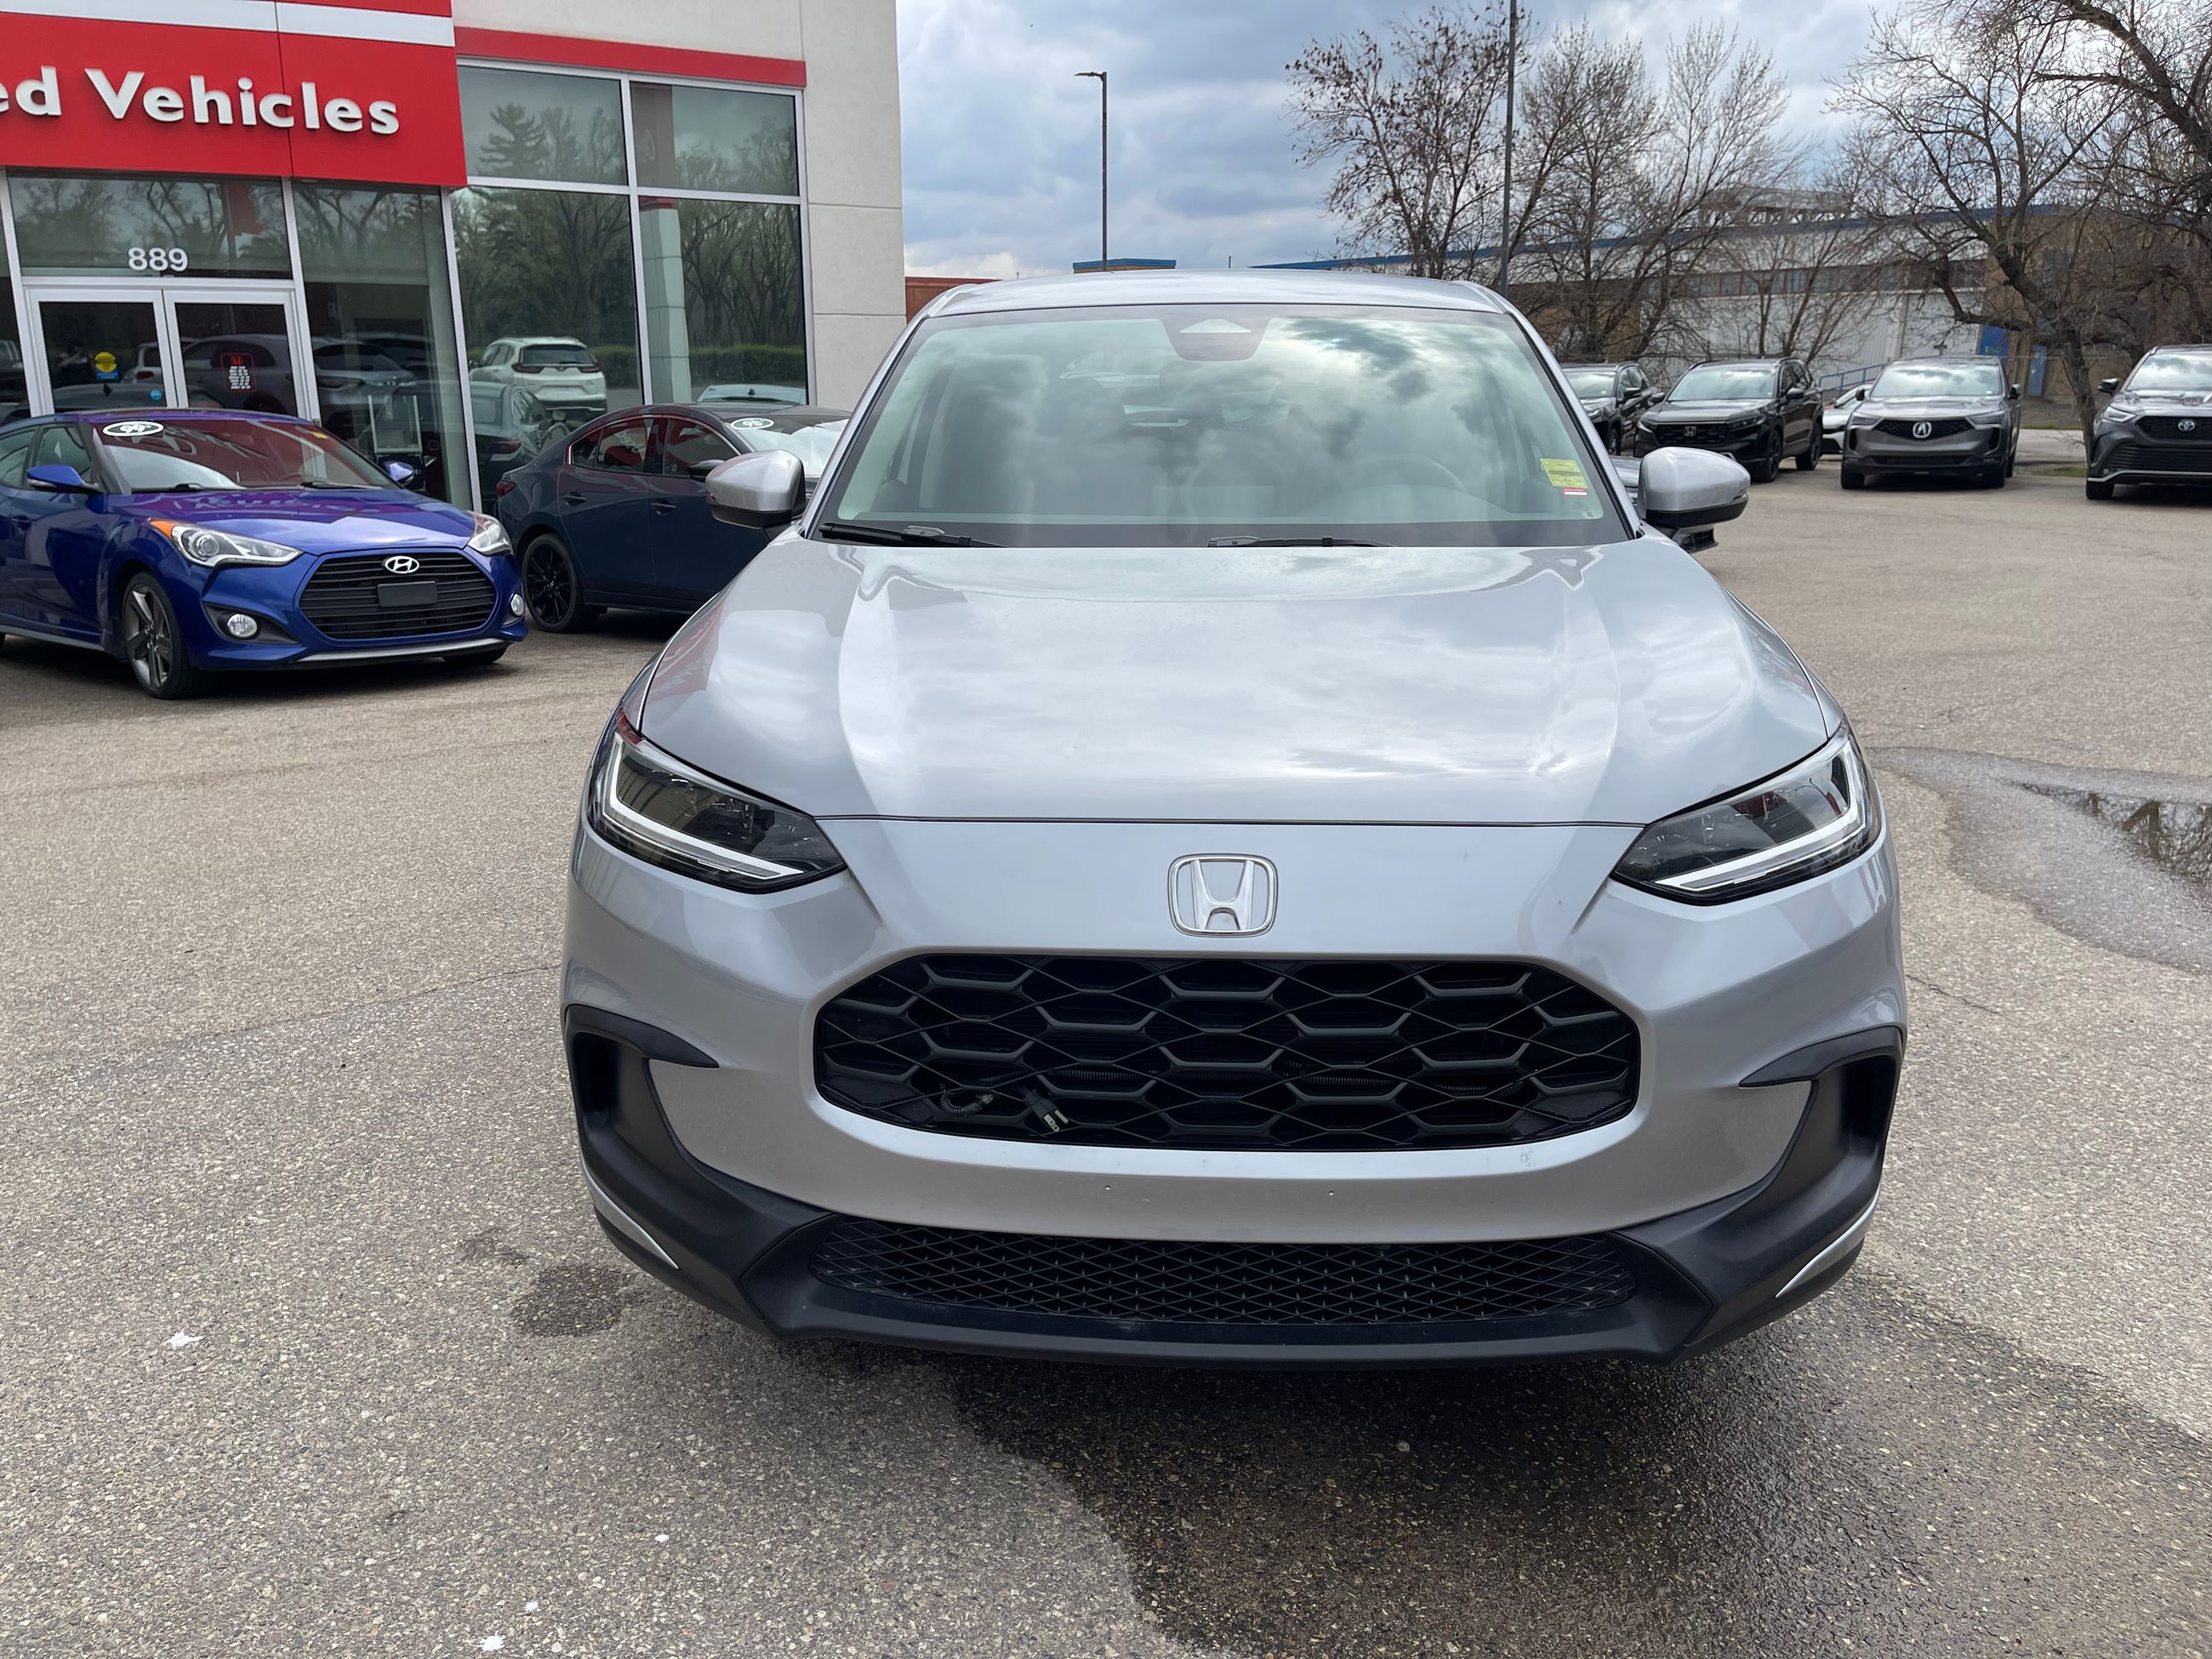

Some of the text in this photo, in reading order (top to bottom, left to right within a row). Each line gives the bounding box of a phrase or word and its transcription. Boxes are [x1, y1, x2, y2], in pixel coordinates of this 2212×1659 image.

[0, 65, 400, 134] d Vehicles
[128, 247, 188, 272] 889
